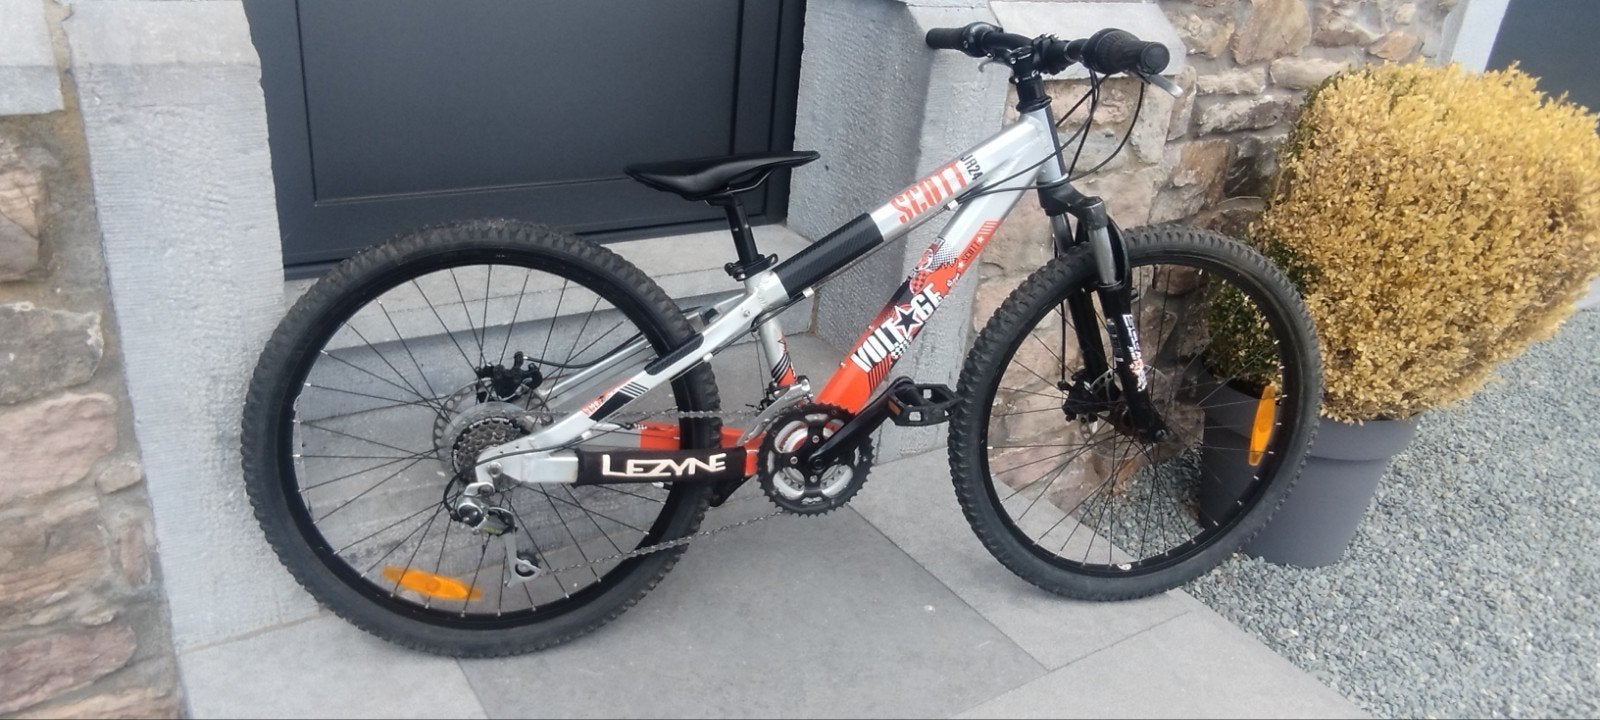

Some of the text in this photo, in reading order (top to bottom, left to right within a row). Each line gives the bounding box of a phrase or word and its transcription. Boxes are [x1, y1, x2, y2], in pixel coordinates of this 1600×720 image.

[889, 154, 983, 224] SCOTT JR24
[961, 239, 981, 263] SCOTT
[850, 283, 943, 373] VOLTGE
[602, 453, 727, 477] LEZYNE
